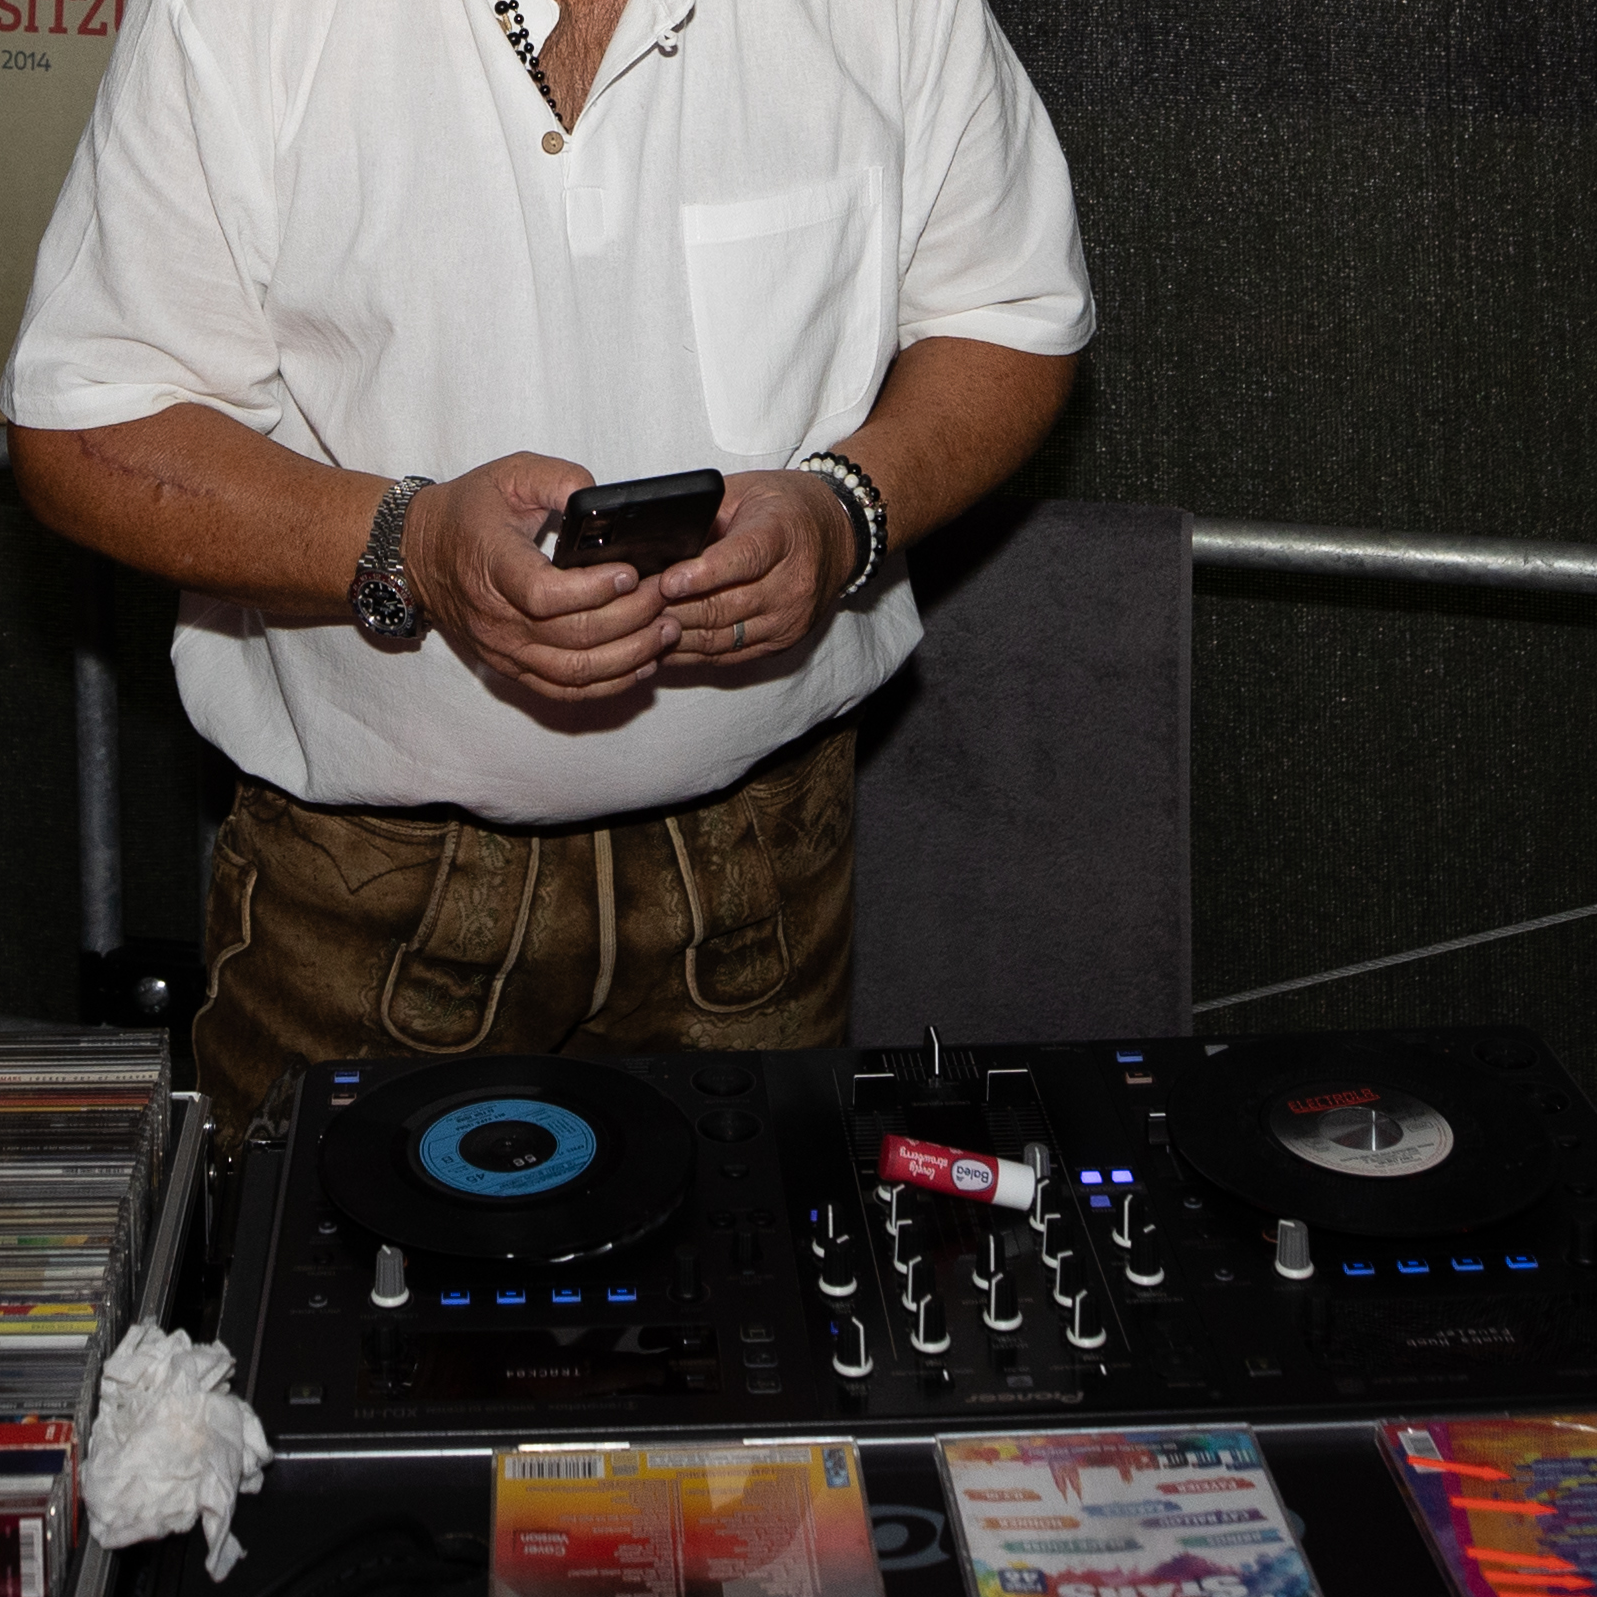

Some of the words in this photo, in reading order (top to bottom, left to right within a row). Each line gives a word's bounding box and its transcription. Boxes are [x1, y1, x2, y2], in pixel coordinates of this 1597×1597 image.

[2, 50, 52, 72] 2014
[1287, 1088, 1381, 1113] ELECTROLA
[899, 1146, 949, 1169] strawberry
[908, 1161, 936, 1181] lovely
[956, 1165, 990, 1184] Balea
[519, 1531, 570, 1546] Version
[523, 1543, 566, 1557] Cover
